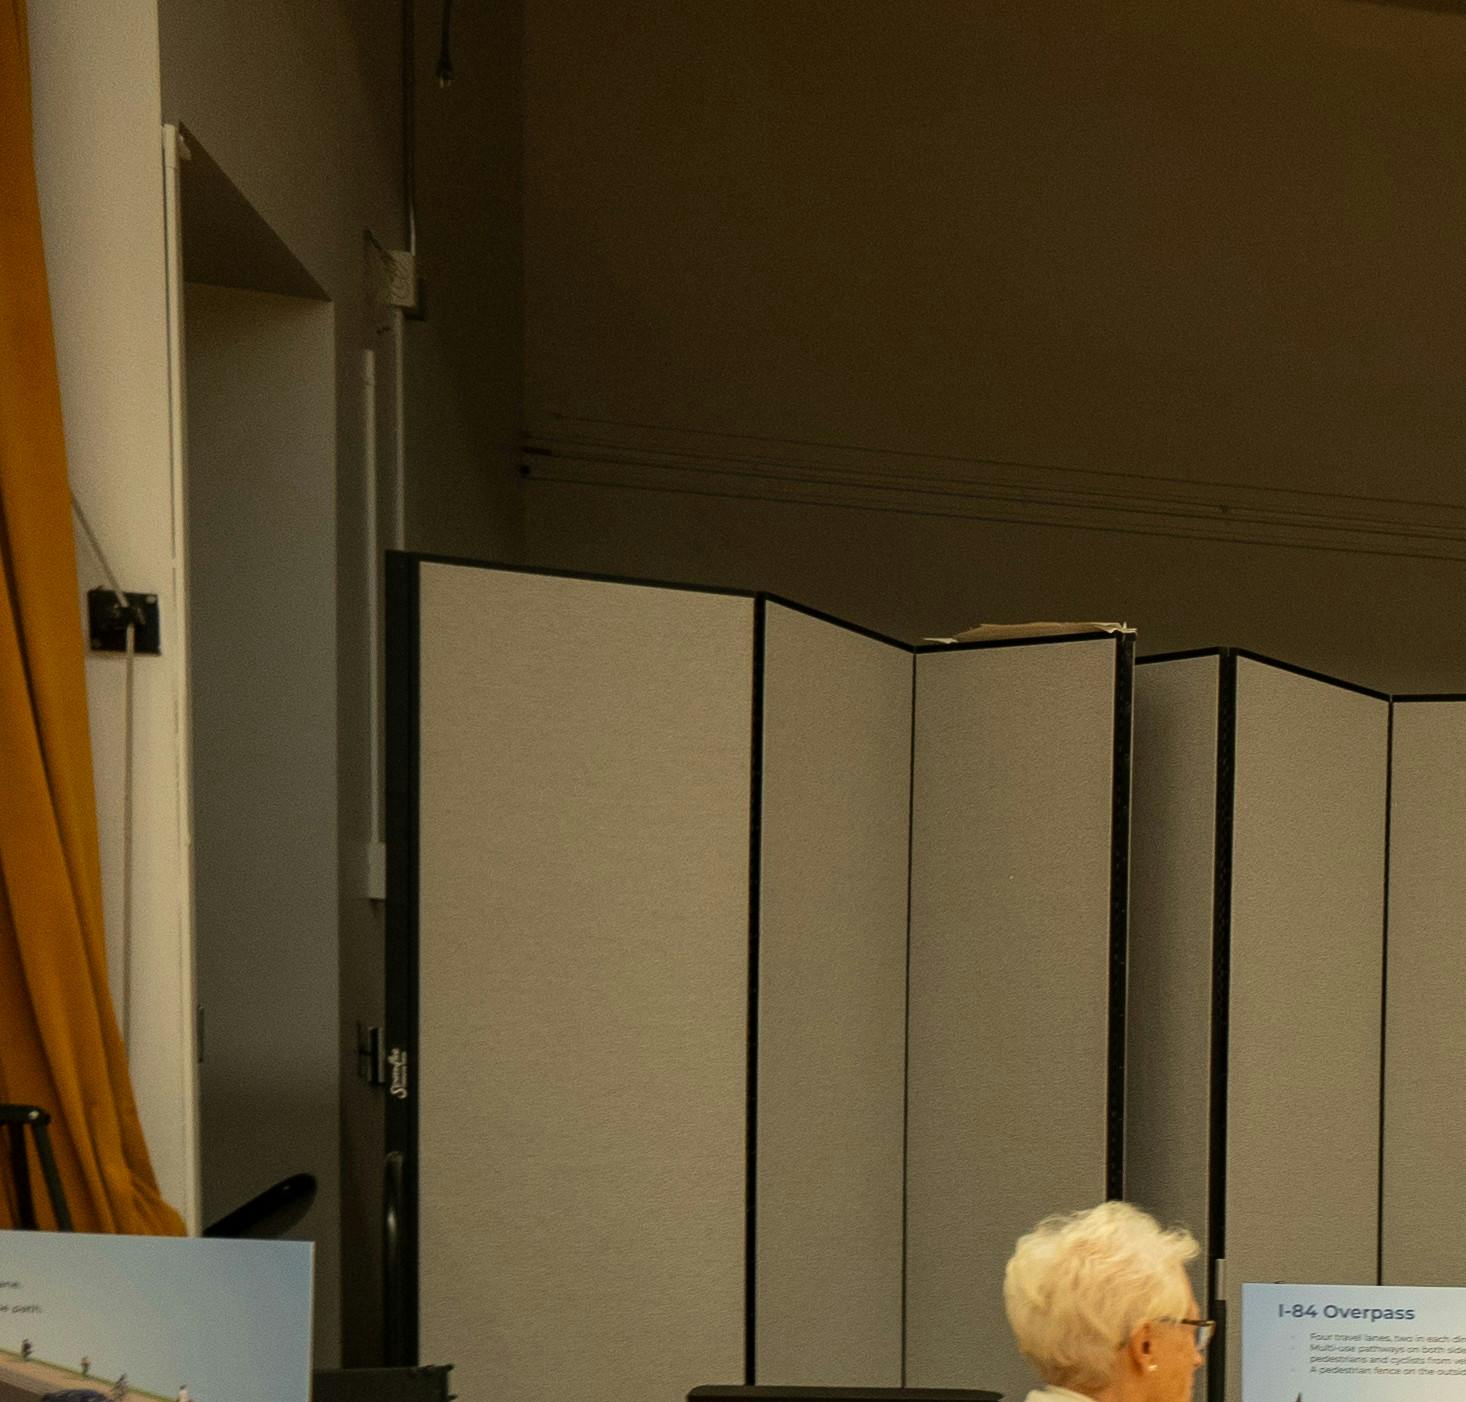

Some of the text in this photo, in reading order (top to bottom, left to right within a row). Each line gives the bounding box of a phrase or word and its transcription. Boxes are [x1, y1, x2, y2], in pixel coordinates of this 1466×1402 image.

[1278, 1303, 1416, 1323] I-84 Overpass
[1310, 1332, 1332, 1341] Four
[1334, 1333, 1361, 1341] travel
[1310, 1343, 1356, 1352] Multi-use
[1359, 1344, 1405, 1355] pathways
[1422, 1346, 1445, 1354] both
[1310, 1355, 1368, 1364] pedestrians
[1370, 1355, 1388, 1364] and
[1391, 1356, 1425, 1366] cyclists
[1426, 1356, 1453, 1365] from
[1319, 1366, 1371, 1376] pedestrian
[1373, 1366, 1401, 1375] fence
[1418, 1368, 1434, 1376] the
